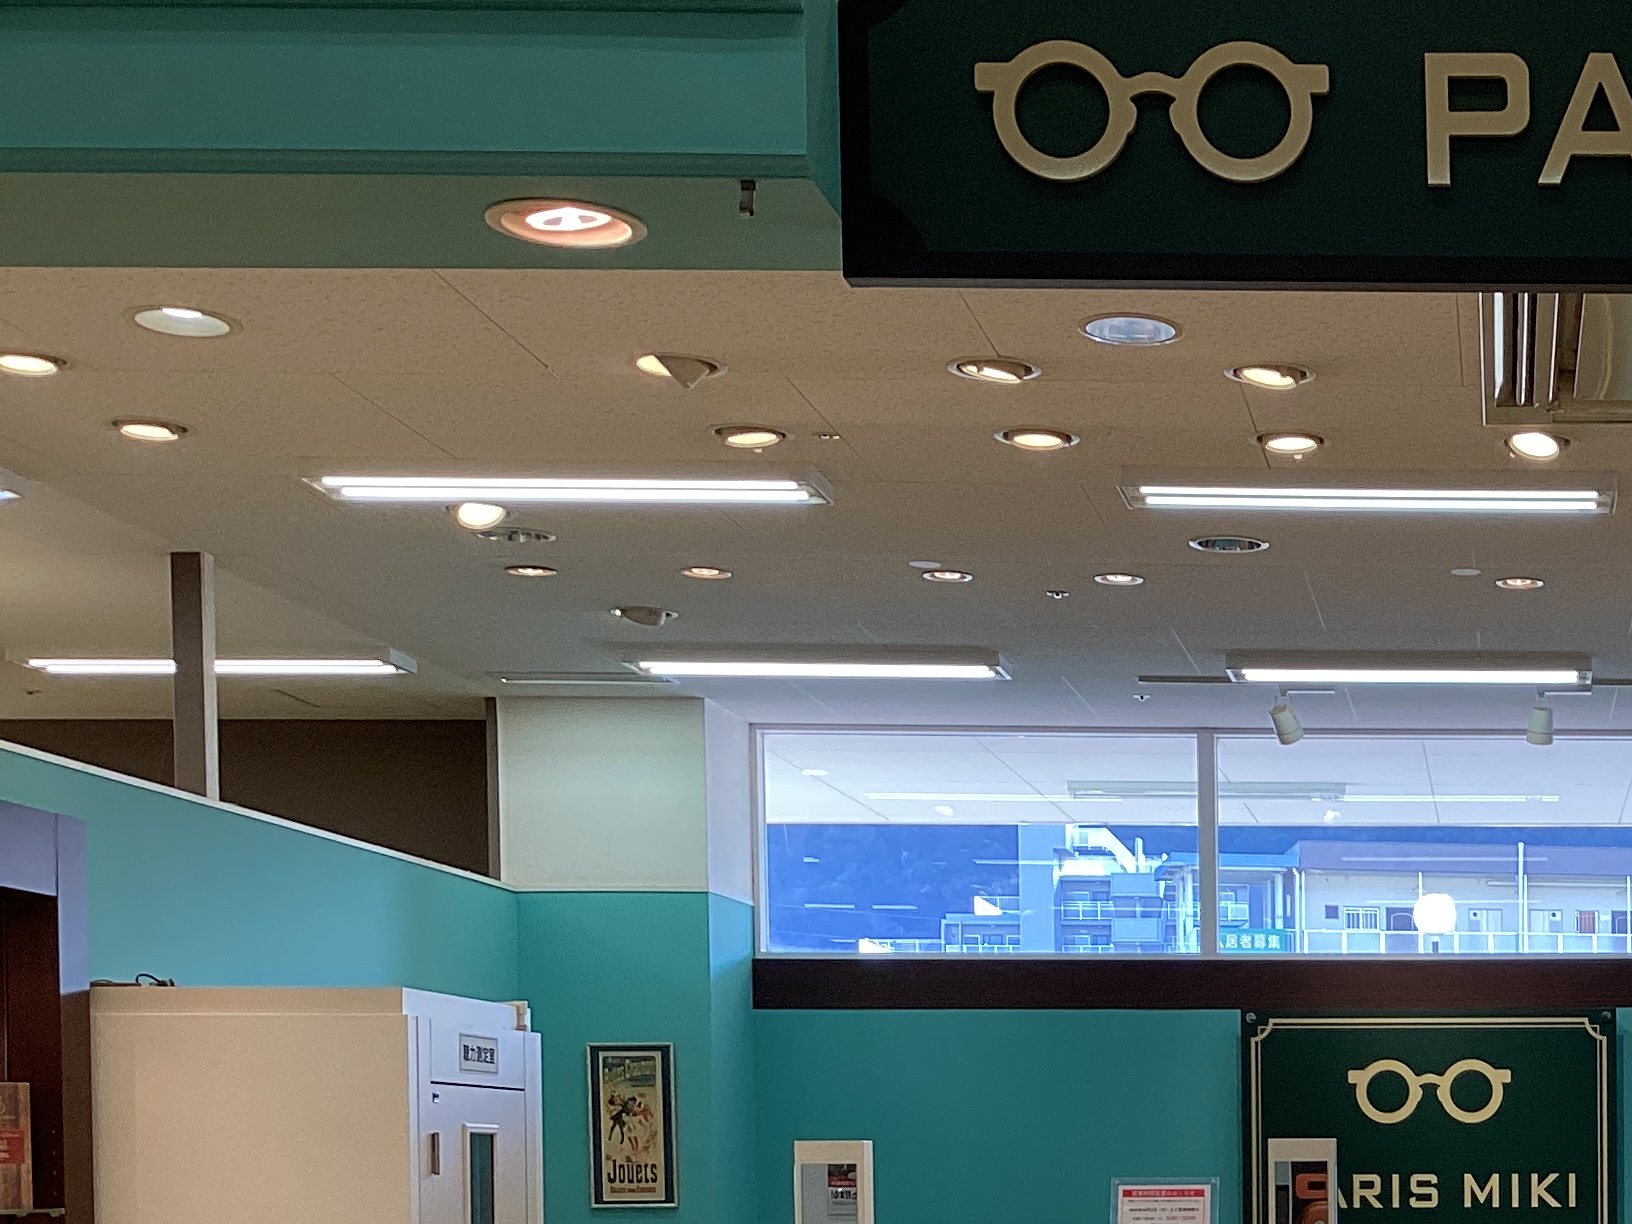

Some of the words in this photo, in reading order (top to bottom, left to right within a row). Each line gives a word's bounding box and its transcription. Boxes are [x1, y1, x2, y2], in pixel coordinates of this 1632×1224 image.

[1220, 933, 1281, 950] 居者募集
[1337, 1173, 1439, 1209] RIS
[1462, 1172, 1577, 1208] MIKI
